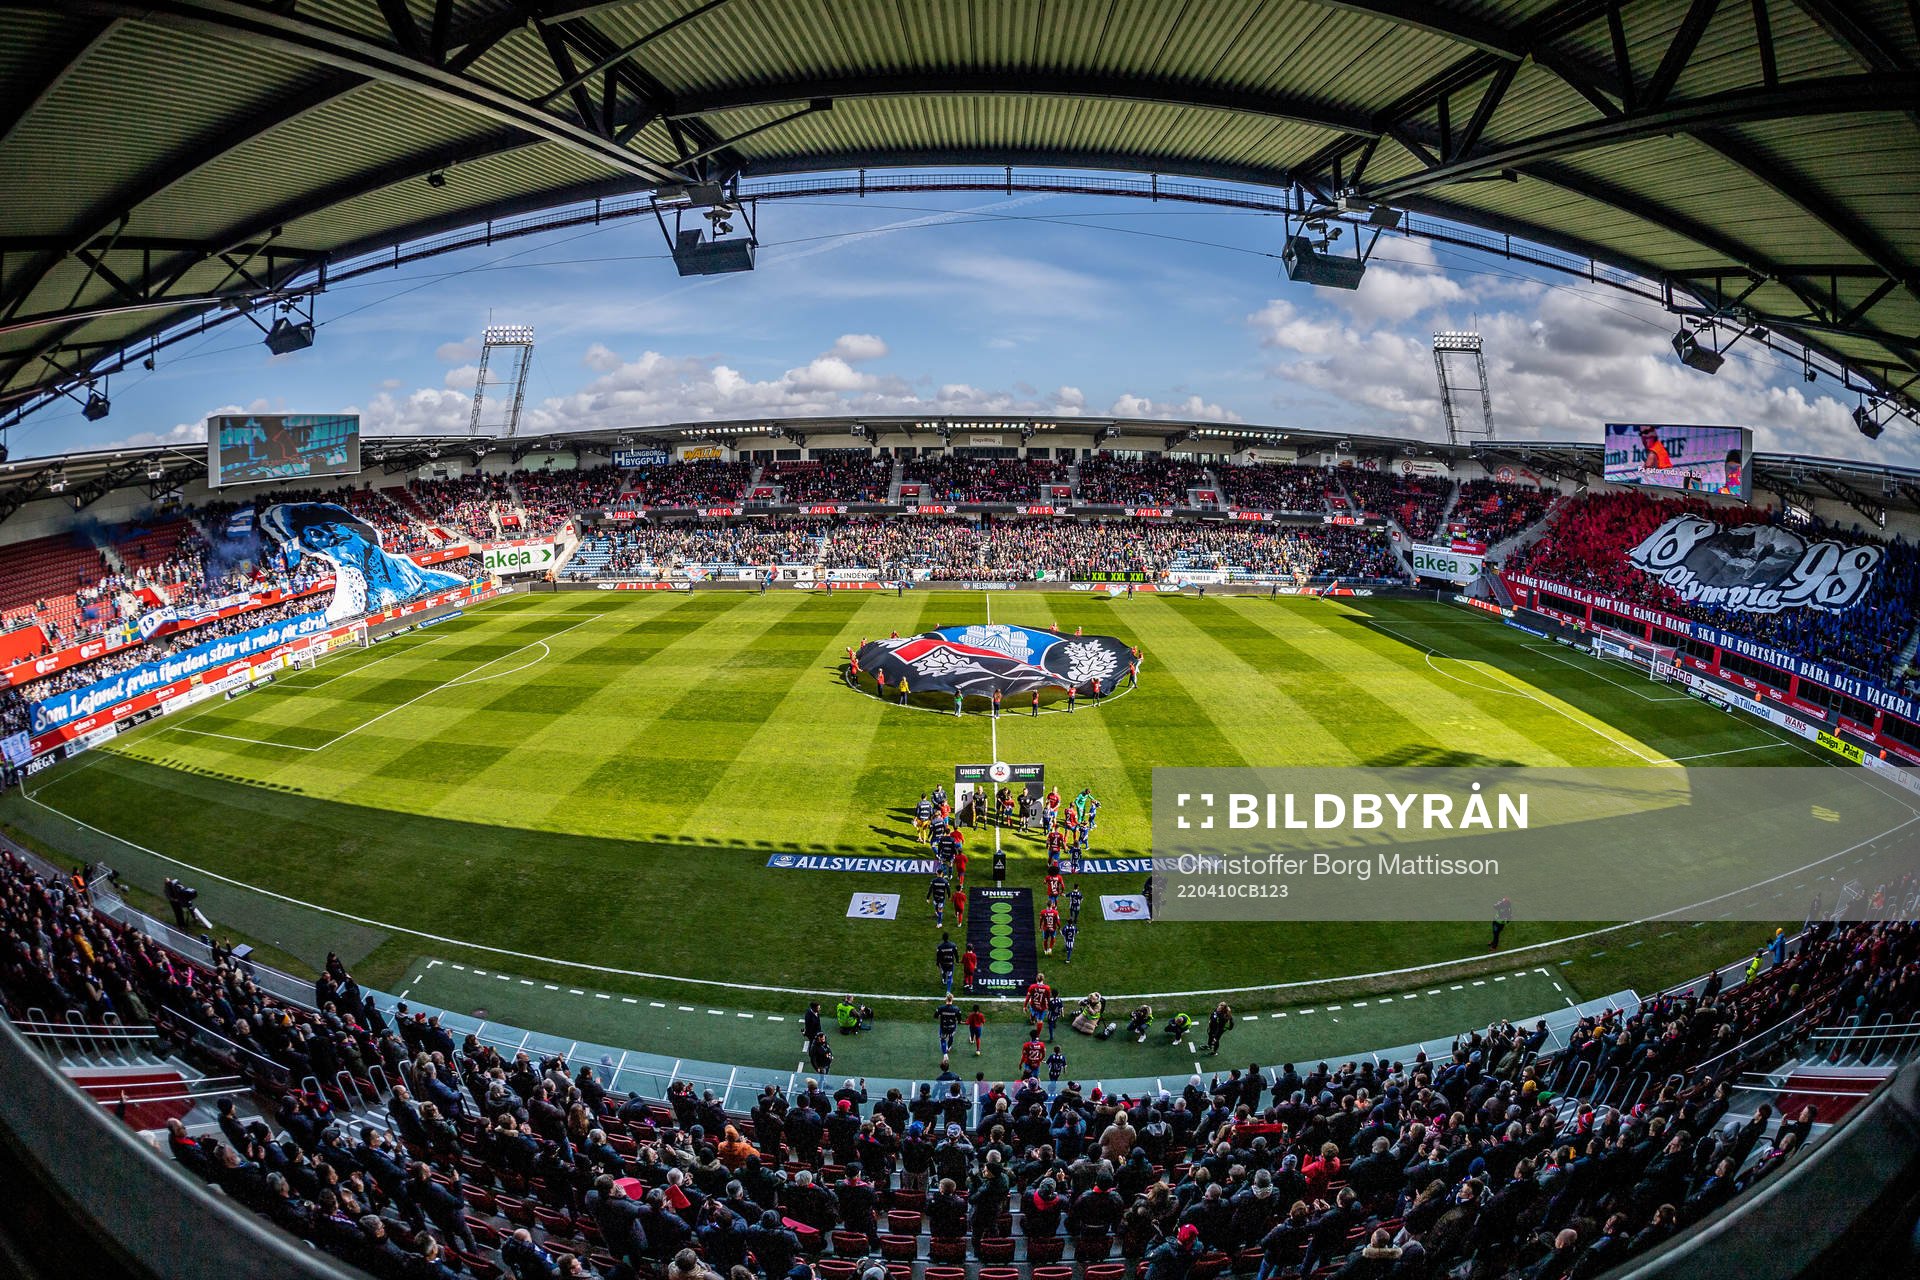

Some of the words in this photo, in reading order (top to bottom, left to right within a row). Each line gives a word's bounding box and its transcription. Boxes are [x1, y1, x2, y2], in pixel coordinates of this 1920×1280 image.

[485, 551, 531, 569] akea
[1414, 554, 1458, 573] akea
[1539, 579, 1573, 599] VÅGORNA
[1594, 596, 1612, 610] MOT
[1614, 602, 1631, 616] VÅR
[1633, 607, 1662, 626] GAMLA
[1697, 627, 1716, 643] SKA
[1720, 635, 1734, 649] DU
[1736, 639, 1796, 672] FORTSÄTTA
[1800, 662, 1830, 685] BÄRA
[1867, 686, 1913, 718] VACKRA
[34, 703, 69, 732] Som
[210, 642, 238, 663] står
[299, 614, 328, 632] strid
[1738, 697, 1771, 719] Tillmobil
[1784, 714, 1807, 731] WANS
[1817, 731, 1839, 749] Design
[1843, 743, 1860, 759] Print
[1014, 767, 1040, 775] UNIBET
[795, 856, 935, 873] ALLSVENSKAN
[978, 978, 1025, 986] UNIBET
